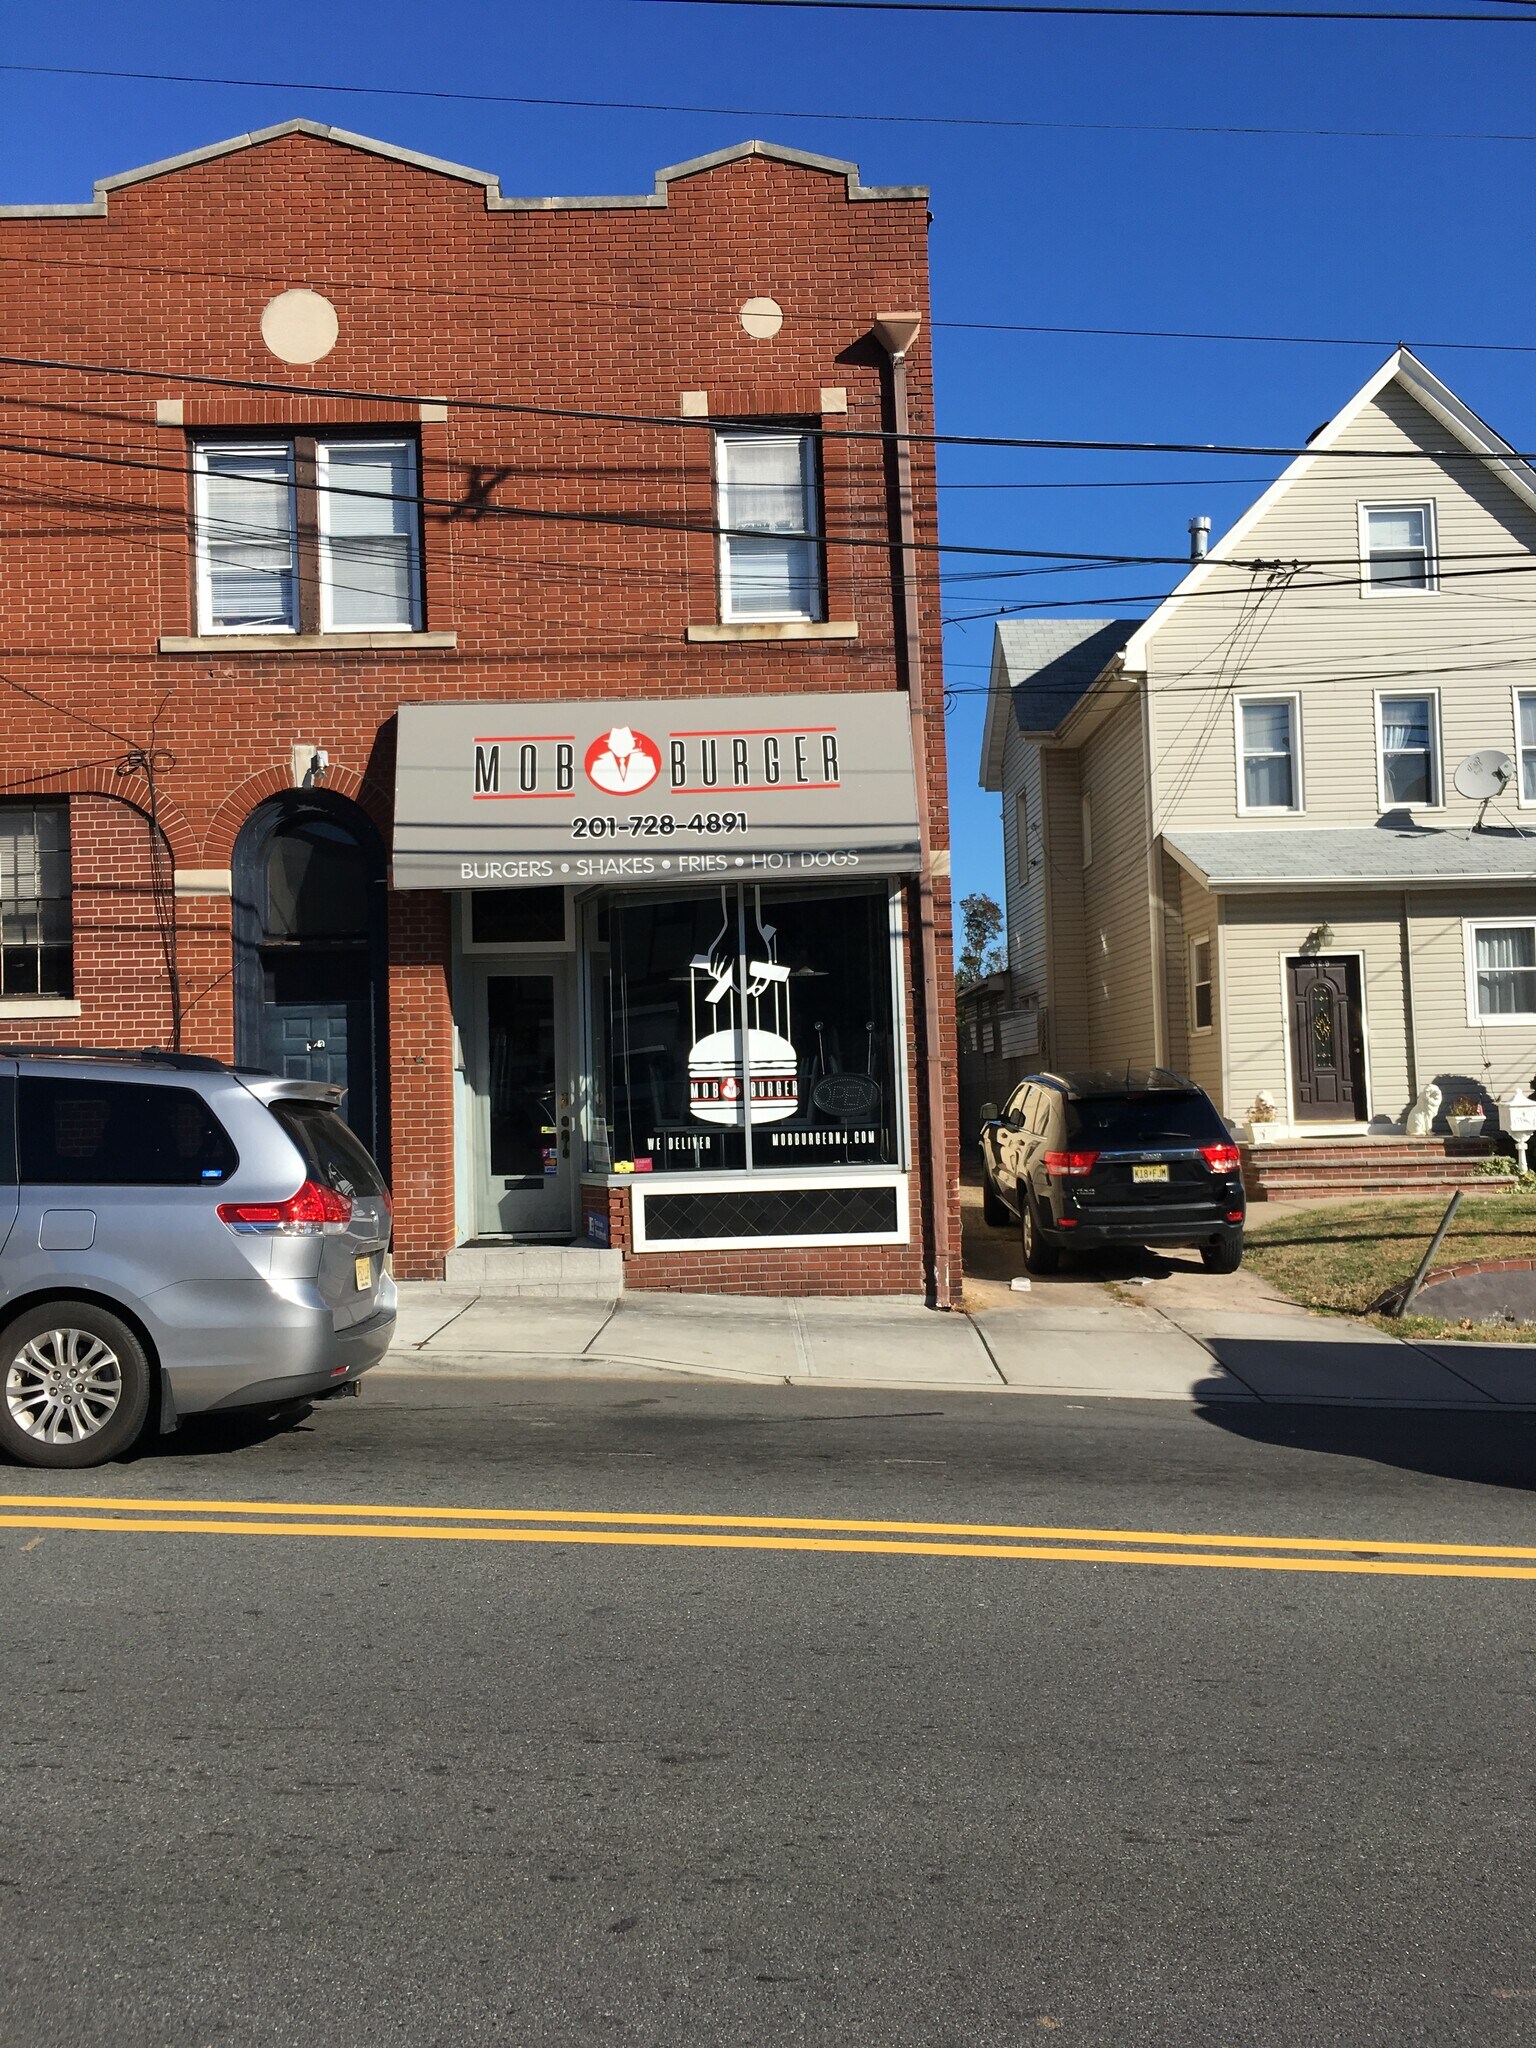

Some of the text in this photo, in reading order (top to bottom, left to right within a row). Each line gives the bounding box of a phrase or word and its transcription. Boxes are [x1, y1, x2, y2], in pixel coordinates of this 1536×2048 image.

[474, 735, 840, 793] MOB BURGER
[572, 812, 749, 839] 201-728-4891
[461, 850, 859, 879] BURGERS SHAKES FRIES HOT DOGS
[690, 1080, 799, 1099] MOB BURGER
[816, 1086, 874, 1106] OPEN
[647, 1136, 711, 1150] WE DELIVER
[772, 1131, 875, 1147] MOBBURGERNJ.COM
